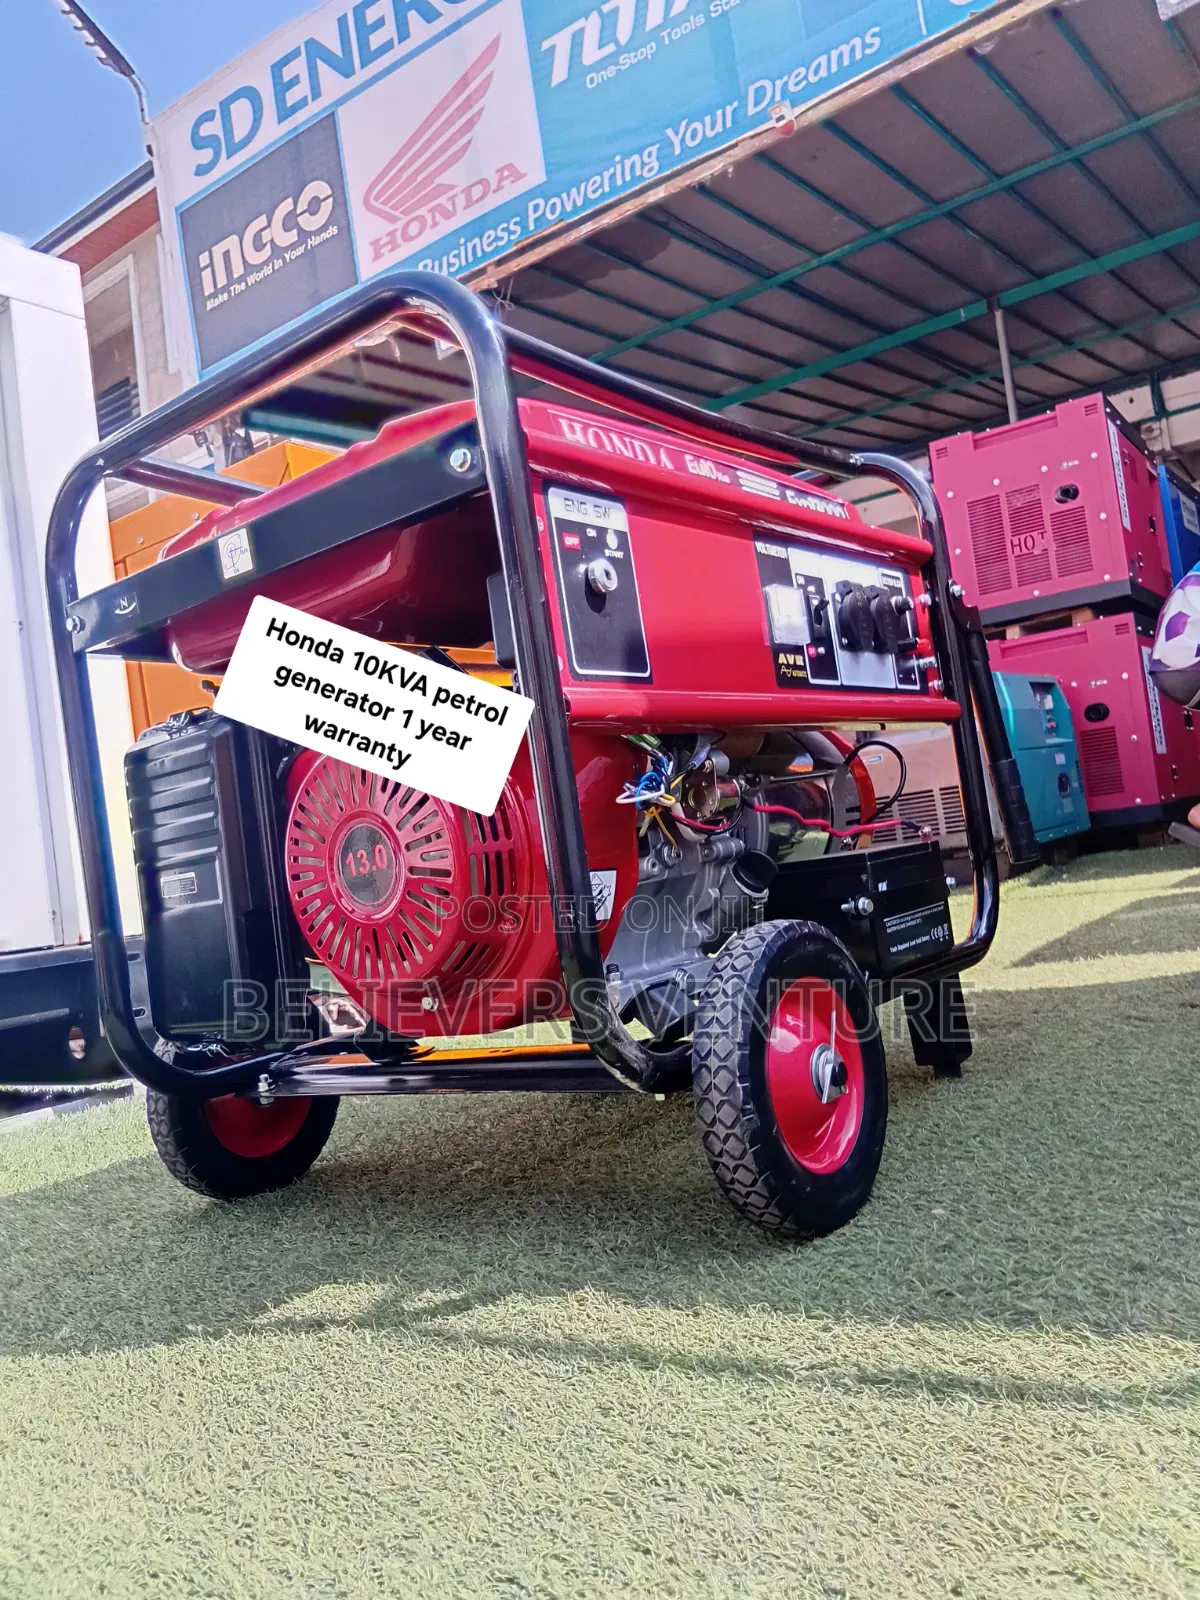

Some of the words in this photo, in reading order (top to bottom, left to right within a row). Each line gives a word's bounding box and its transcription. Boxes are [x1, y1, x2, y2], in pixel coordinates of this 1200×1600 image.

[586, 41, 657, 89] One-Stop
[660, 12, 705, 45] Tools
[189, 85, 264, 177] SD
[270, 0, 467, 125] ENER
[527, 143, 660, 230] Powering
[665, 100, 738, 156] Your
[747, 26, 881, 117] Dreams
[371, 162, 527, 263] HONDA
[206, 292, 228, 311] Make
[229, 281, 246, 296] The
[246, 264, 273, 286] World
[283, 244, 306, 264] Your
[307, 225, 339, 249] Hands
[558, 418, 674, 470] HONDA
[563, 497, 591, 516] ENG.
[593, 504, 611, 519] SW
[565, 536, 579, 546] OFF
[586, 528, 597, 537] ON
[1010, 530, 1047, 555] HOT
[604, 549, 624, 559] START
[778, 652, 804, 666] AVR
[346, 844, 388, 878] 13.0
